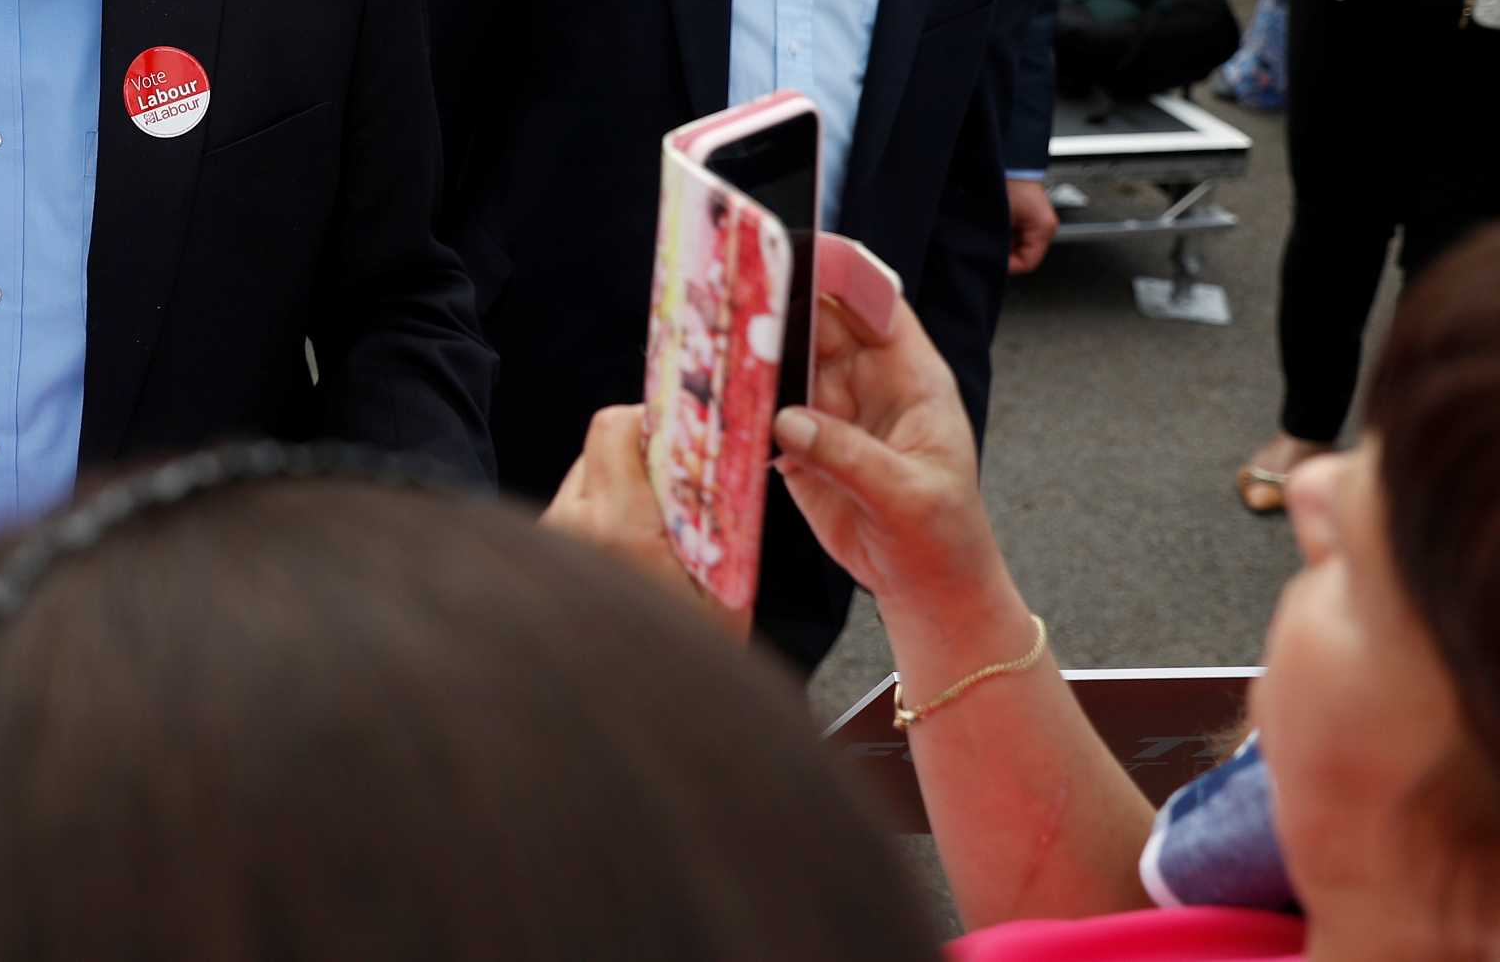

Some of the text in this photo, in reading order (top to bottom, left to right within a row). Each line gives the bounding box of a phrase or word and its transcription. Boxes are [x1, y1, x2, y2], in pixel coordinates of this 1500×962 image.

[130, 71, 168, 91] Vote
[137, 80, 198, 111] Labour
[153, 98, 200, 122] Labour
